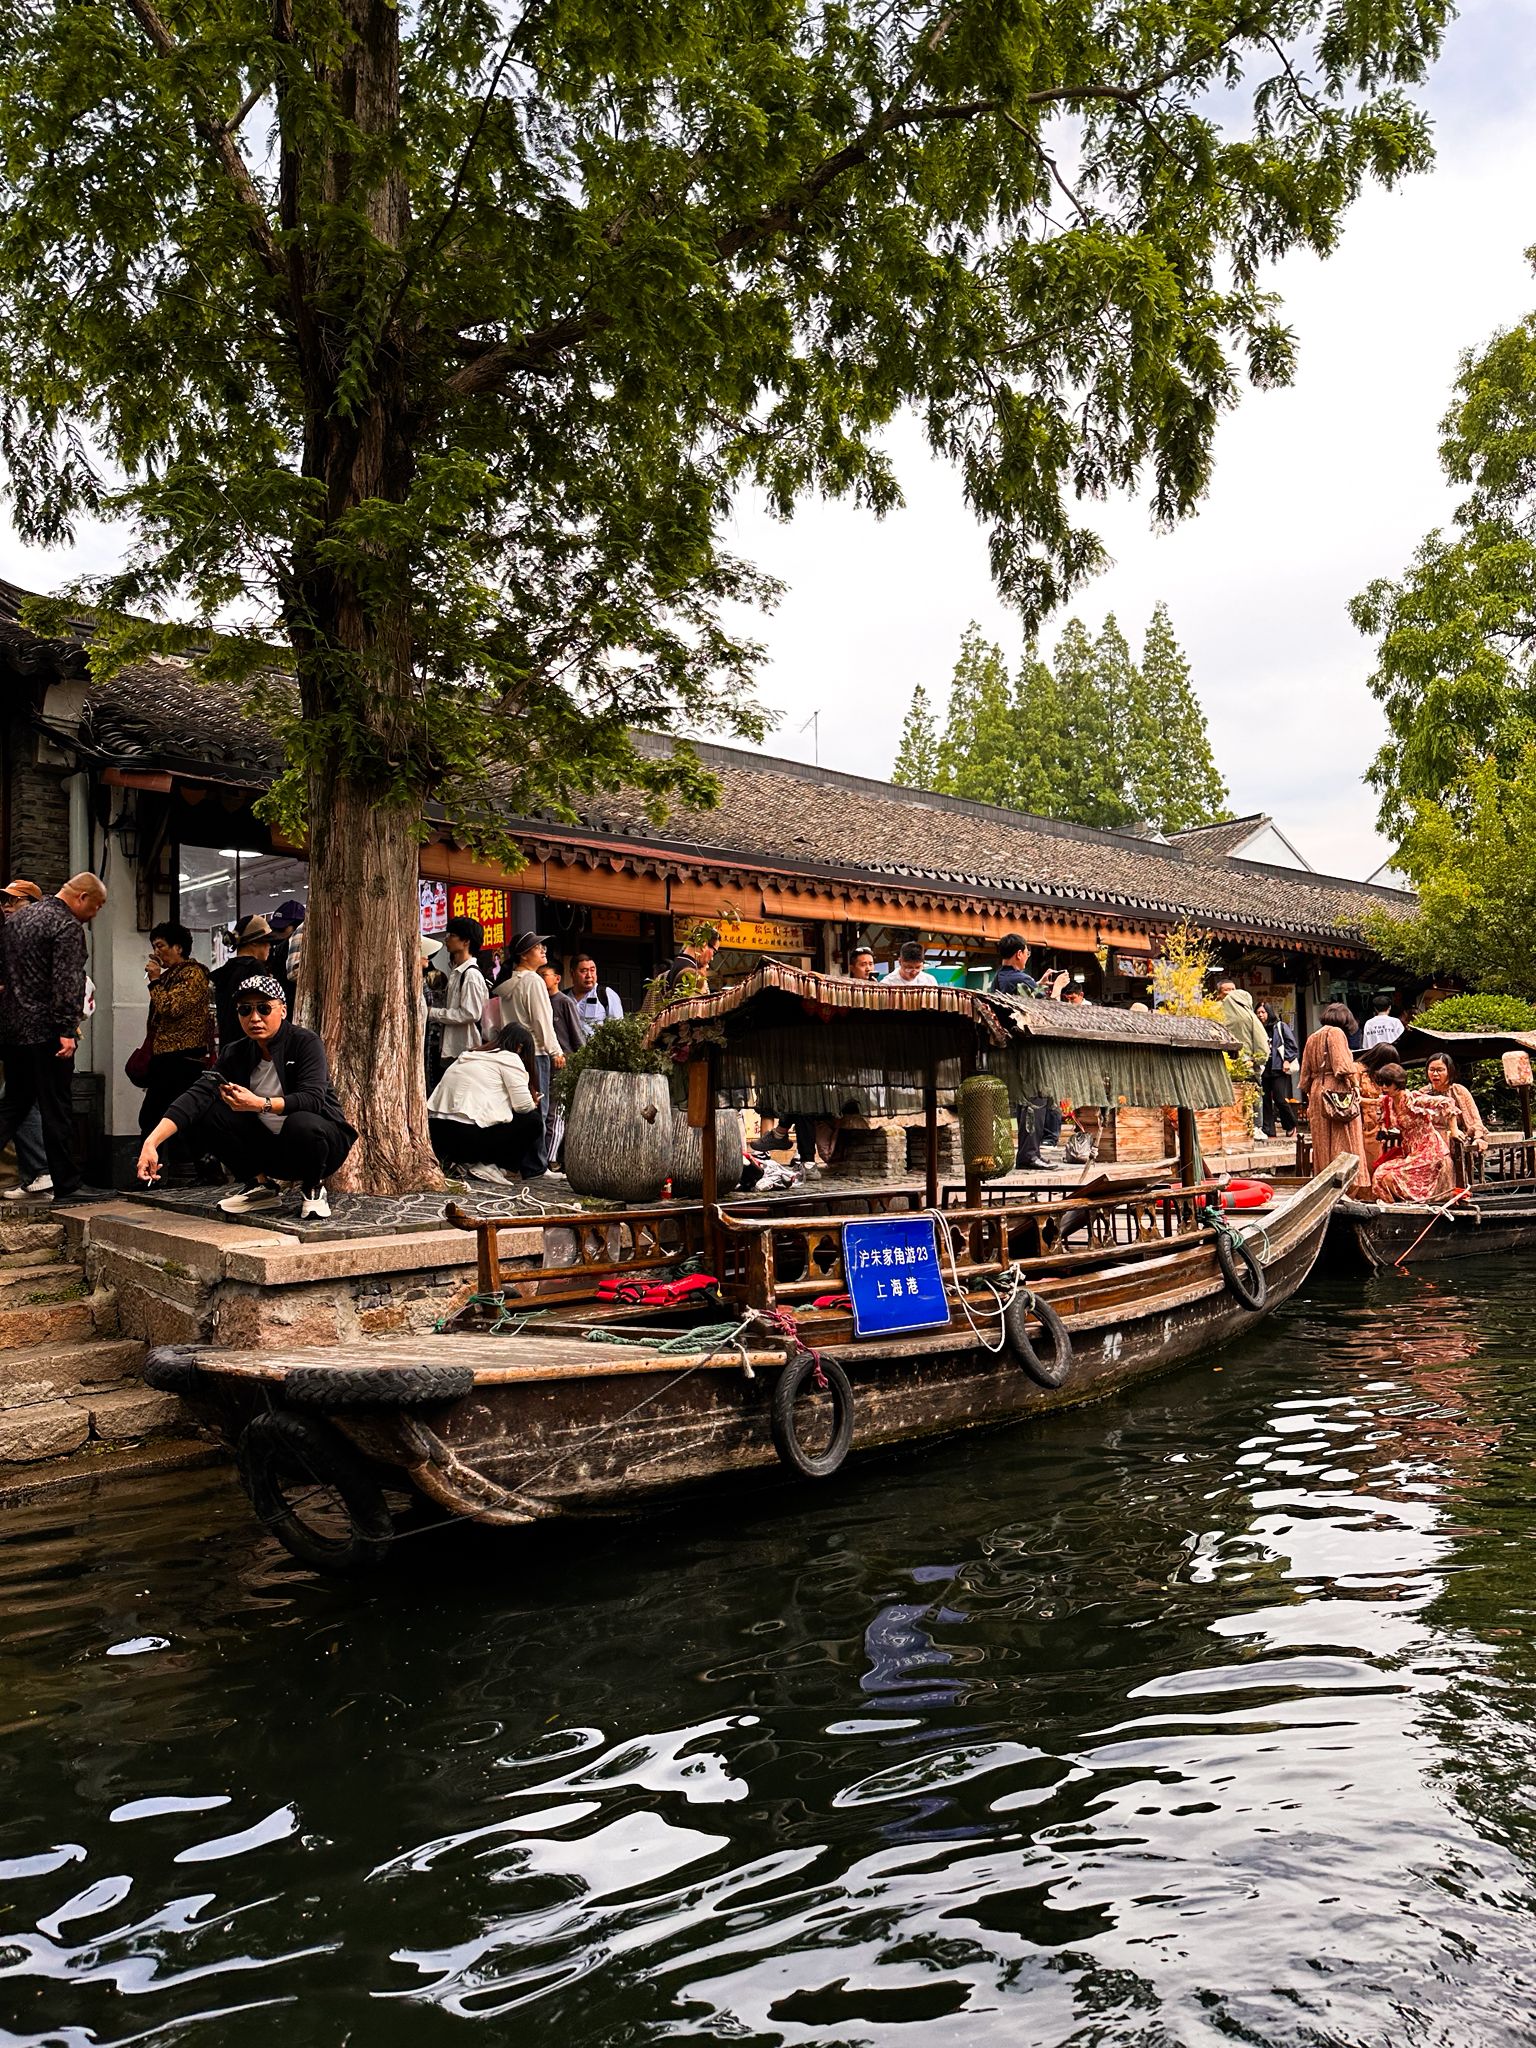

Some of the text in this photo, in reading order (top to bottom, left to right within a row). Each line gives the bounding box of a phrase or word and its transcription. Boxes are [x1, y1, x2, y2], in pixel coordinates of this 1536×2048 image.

[453, 888, 508, 922] 免费装造
[859, 1246, 928, 1268] 沪朱家角游23
[876, 1277, 919, 1299] 上海港
